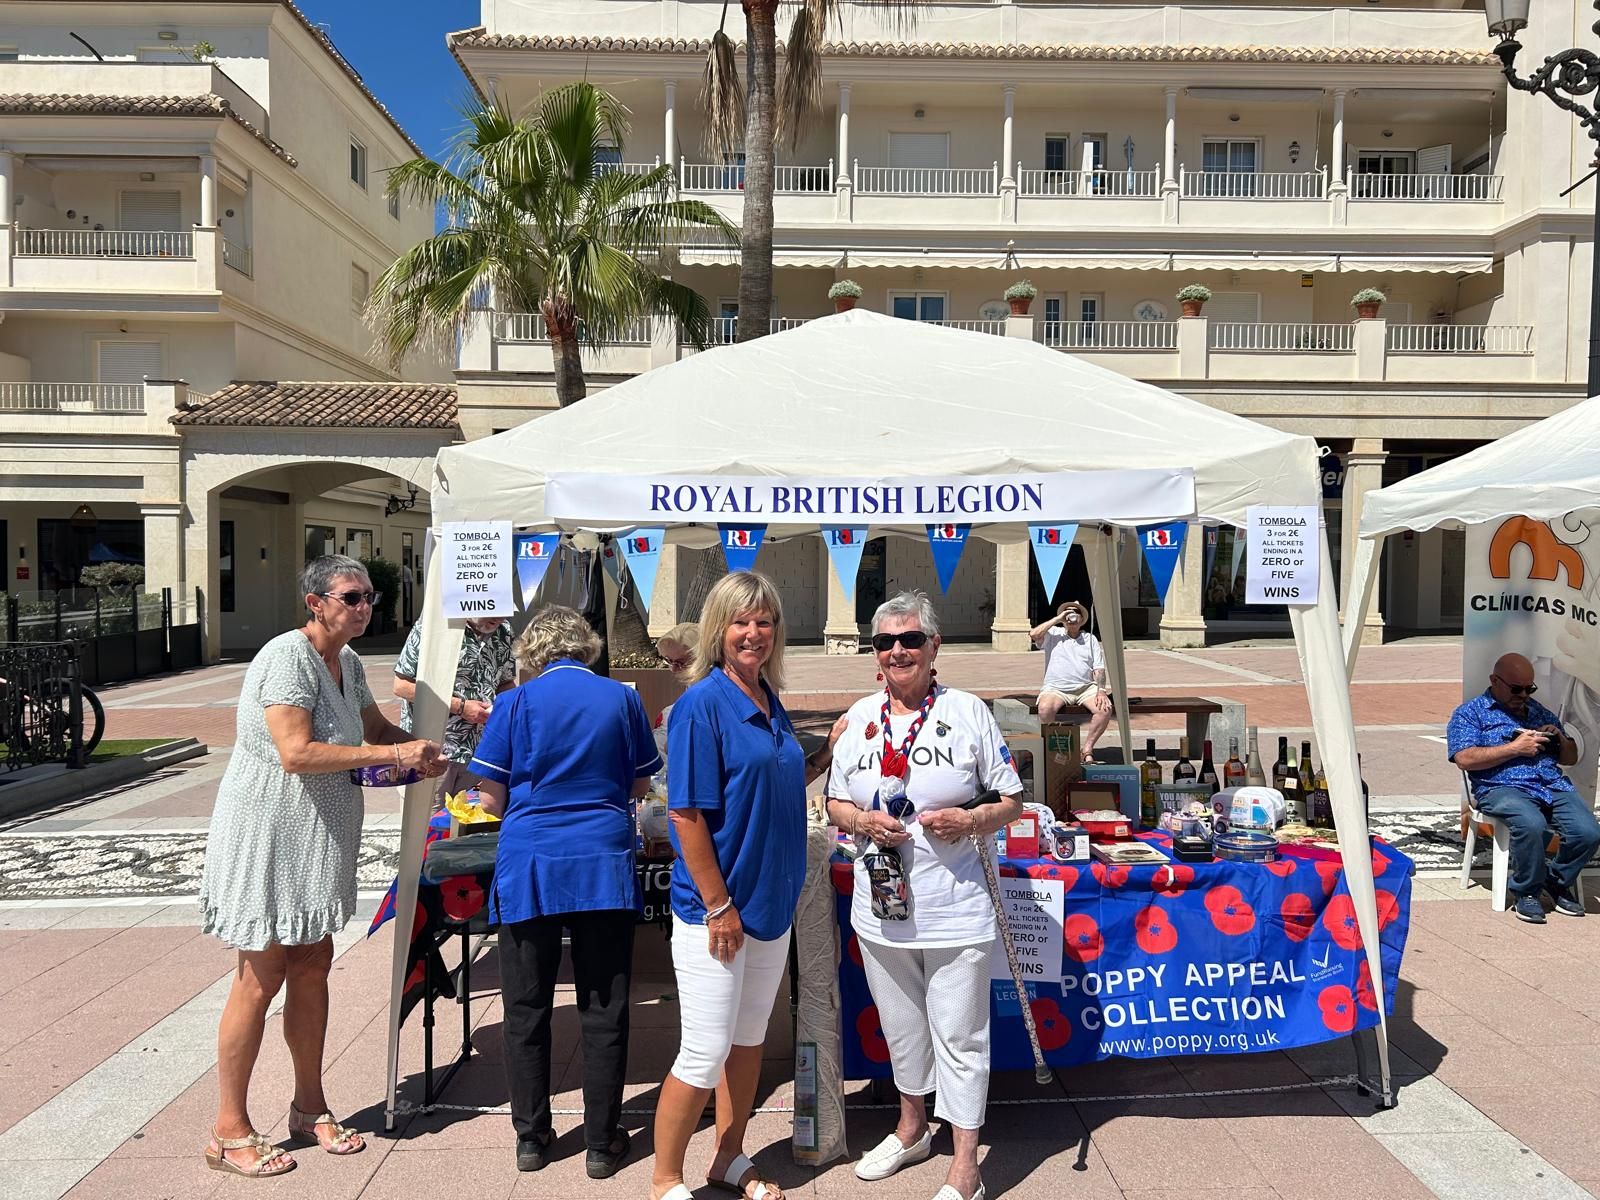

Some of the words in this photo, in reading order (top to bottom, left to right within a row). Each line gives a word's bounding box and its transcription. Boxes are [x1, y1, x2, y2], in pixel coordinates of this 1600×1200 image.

[649, 484, 763, 513] ROYAL
[770, 486, 904, 514] BRITISH
[913, 483, 1043, 514] LEGION
[1259, 518, 1306, 526] TOMBOLA
[454, 532, 500, 541] TOMBOLA
[456, 572, 484, 580] ZERO
[466, 584, 488, 592] FIVE
[1264, 587, 1299, 597] WINS
[460, 600, 496, 611] WINS
[1471, 592, 1565, 615] CLÍNICAS
[1572, 604, 1598, 626] MC
[1160, 792, 1174, 800] YOU
[1005, 890, 1052, 901] TOMBOLA
[1016, 947, 1038, 956] FIVE
[1018, 963, 1043, 974] INS
[1060, 963, 1167, 997] POPPY
[1184, 960, 1305, 987] APPEAL
[996, 990, 1036, 1000] LEGN
[1081, 995, 1286, 1030] COLLECTION
[1100, 1030, 1280, 1054] www.poppy.org.uk
